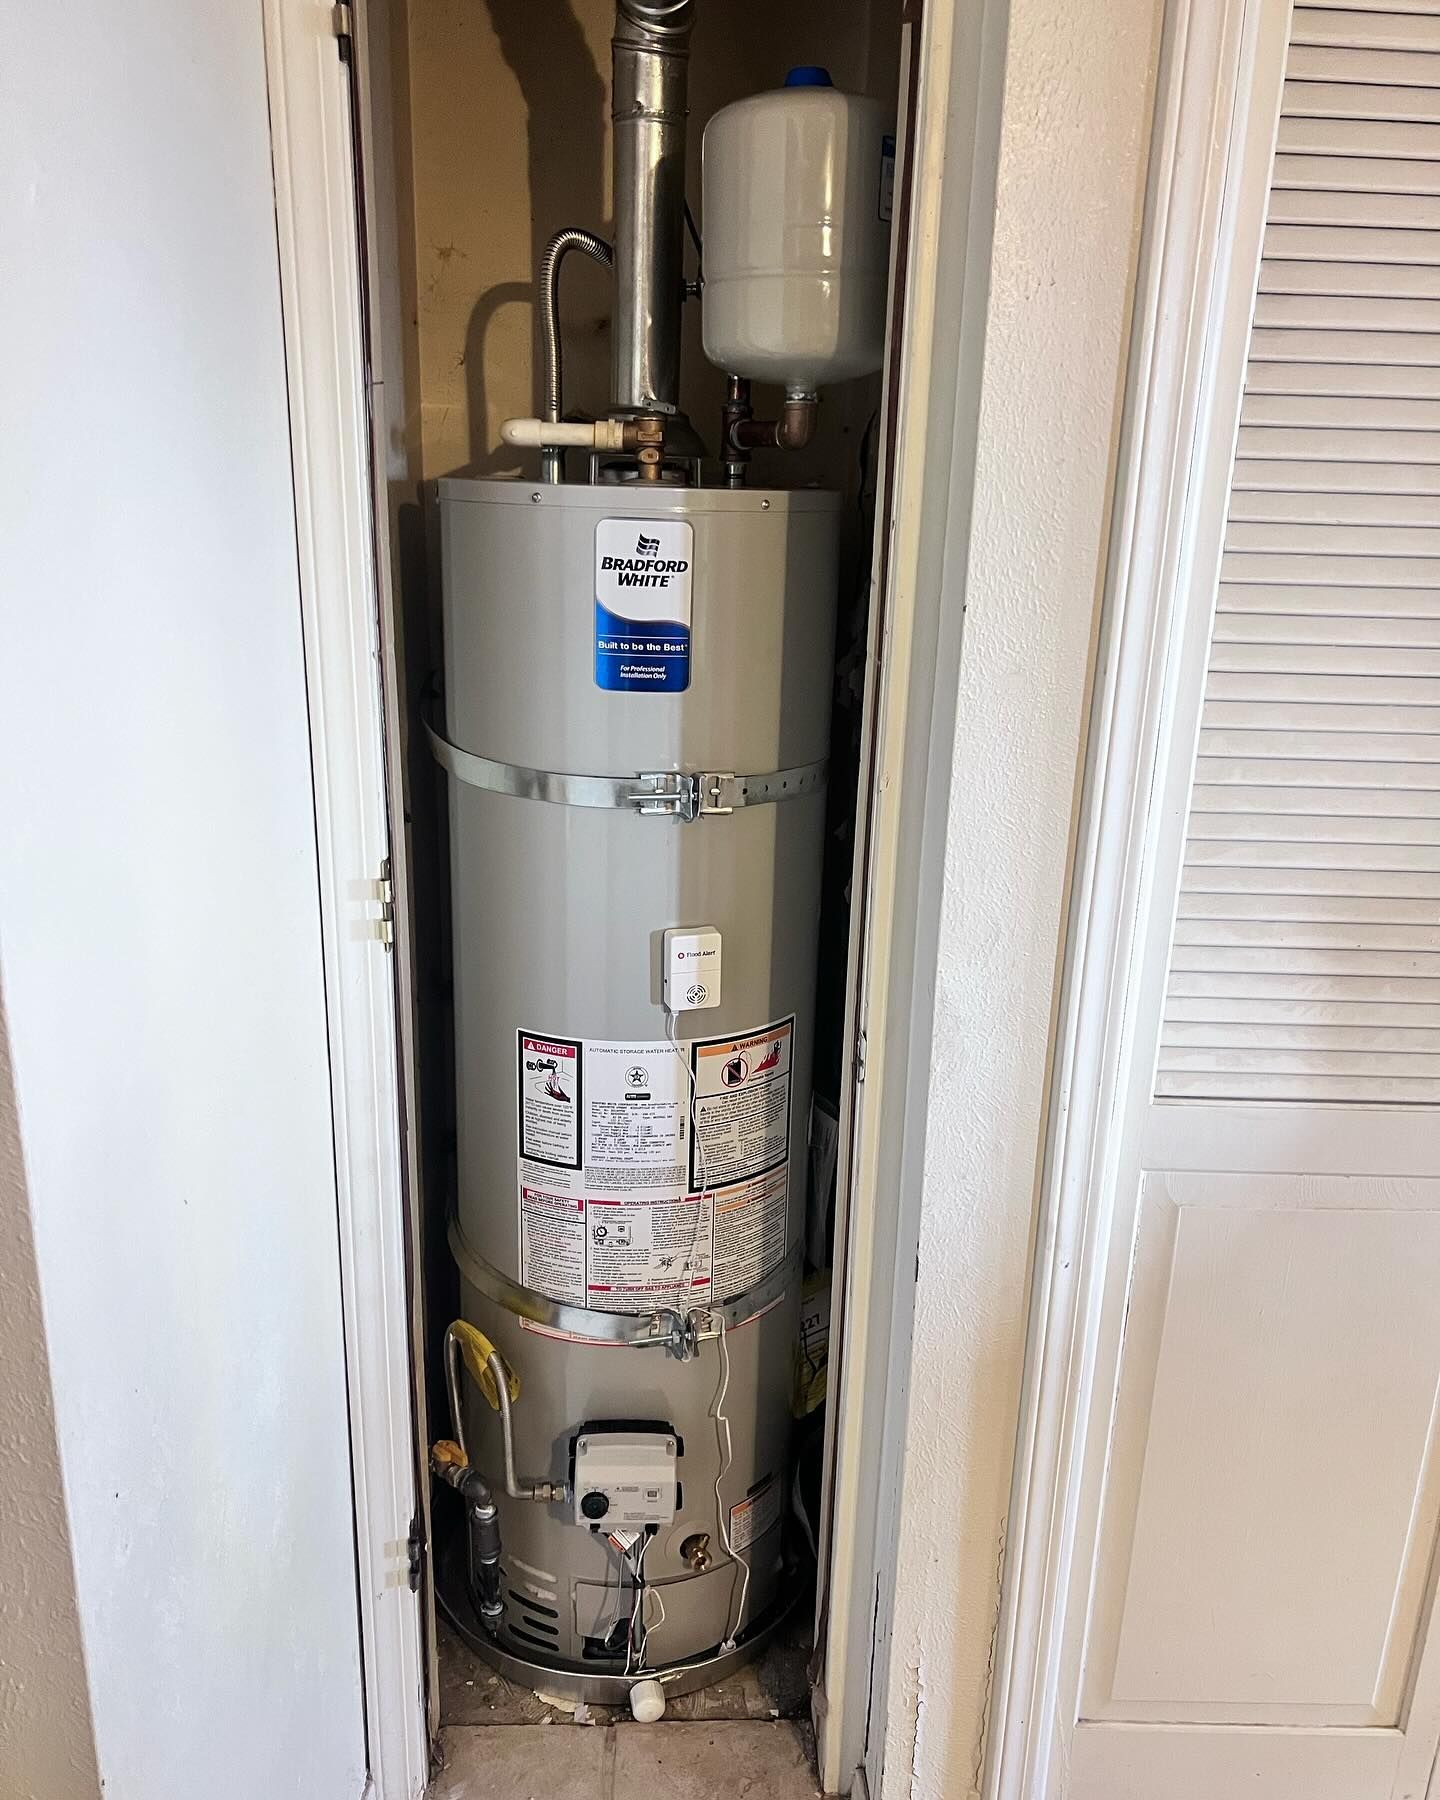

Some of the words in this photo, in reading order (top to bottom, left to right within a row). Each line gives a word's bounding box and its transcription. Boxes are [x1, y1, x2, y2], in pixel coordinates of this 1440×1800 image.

[601, 556, 689, 572] BRADFORD
[618, 572, 670, 587] WHITE
[598, 641, 618, 649] Built
[620, 642, 629, 650] to
[632, 642, 644, 650] be
[646, 643, 661, 651] the
[663, 643, 684, 651] Best
[740, 1037, 767, 1049] WARNING
[536, 1044, 568, 1055] DANGER
